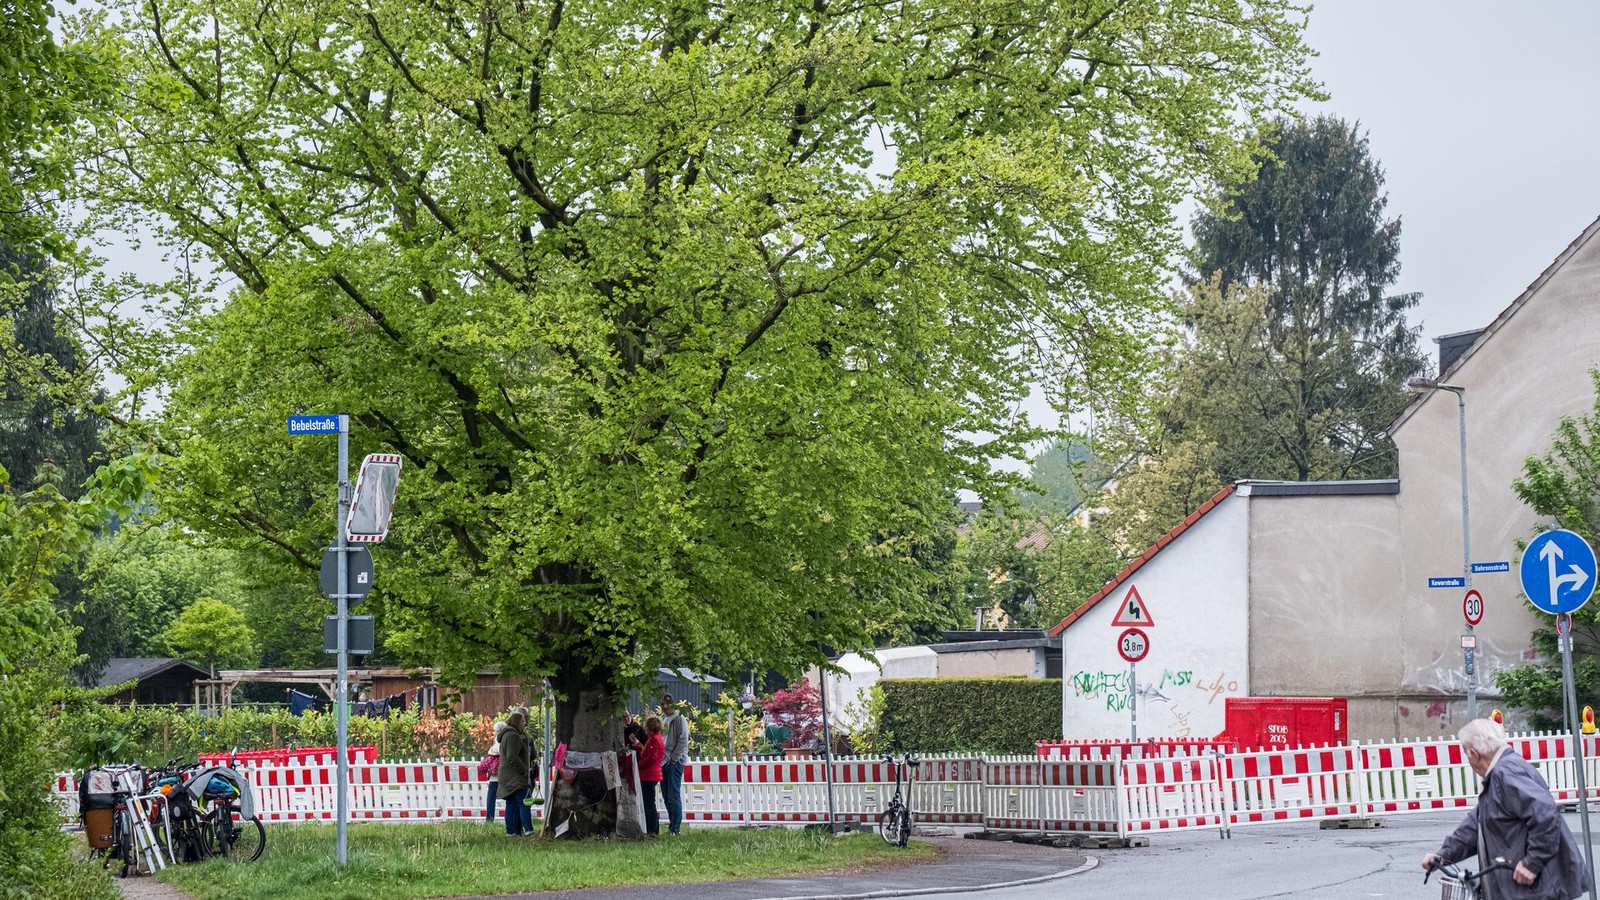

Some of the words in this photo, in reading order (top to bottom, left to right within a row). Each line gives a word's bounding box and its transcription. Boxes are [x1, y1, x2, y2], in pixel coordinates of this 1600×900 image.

[291, 419, 335, 431] Bebelstraße
[1467, 599, 1480, 616] 30
[1159, 668, 1193, 689] MSV
